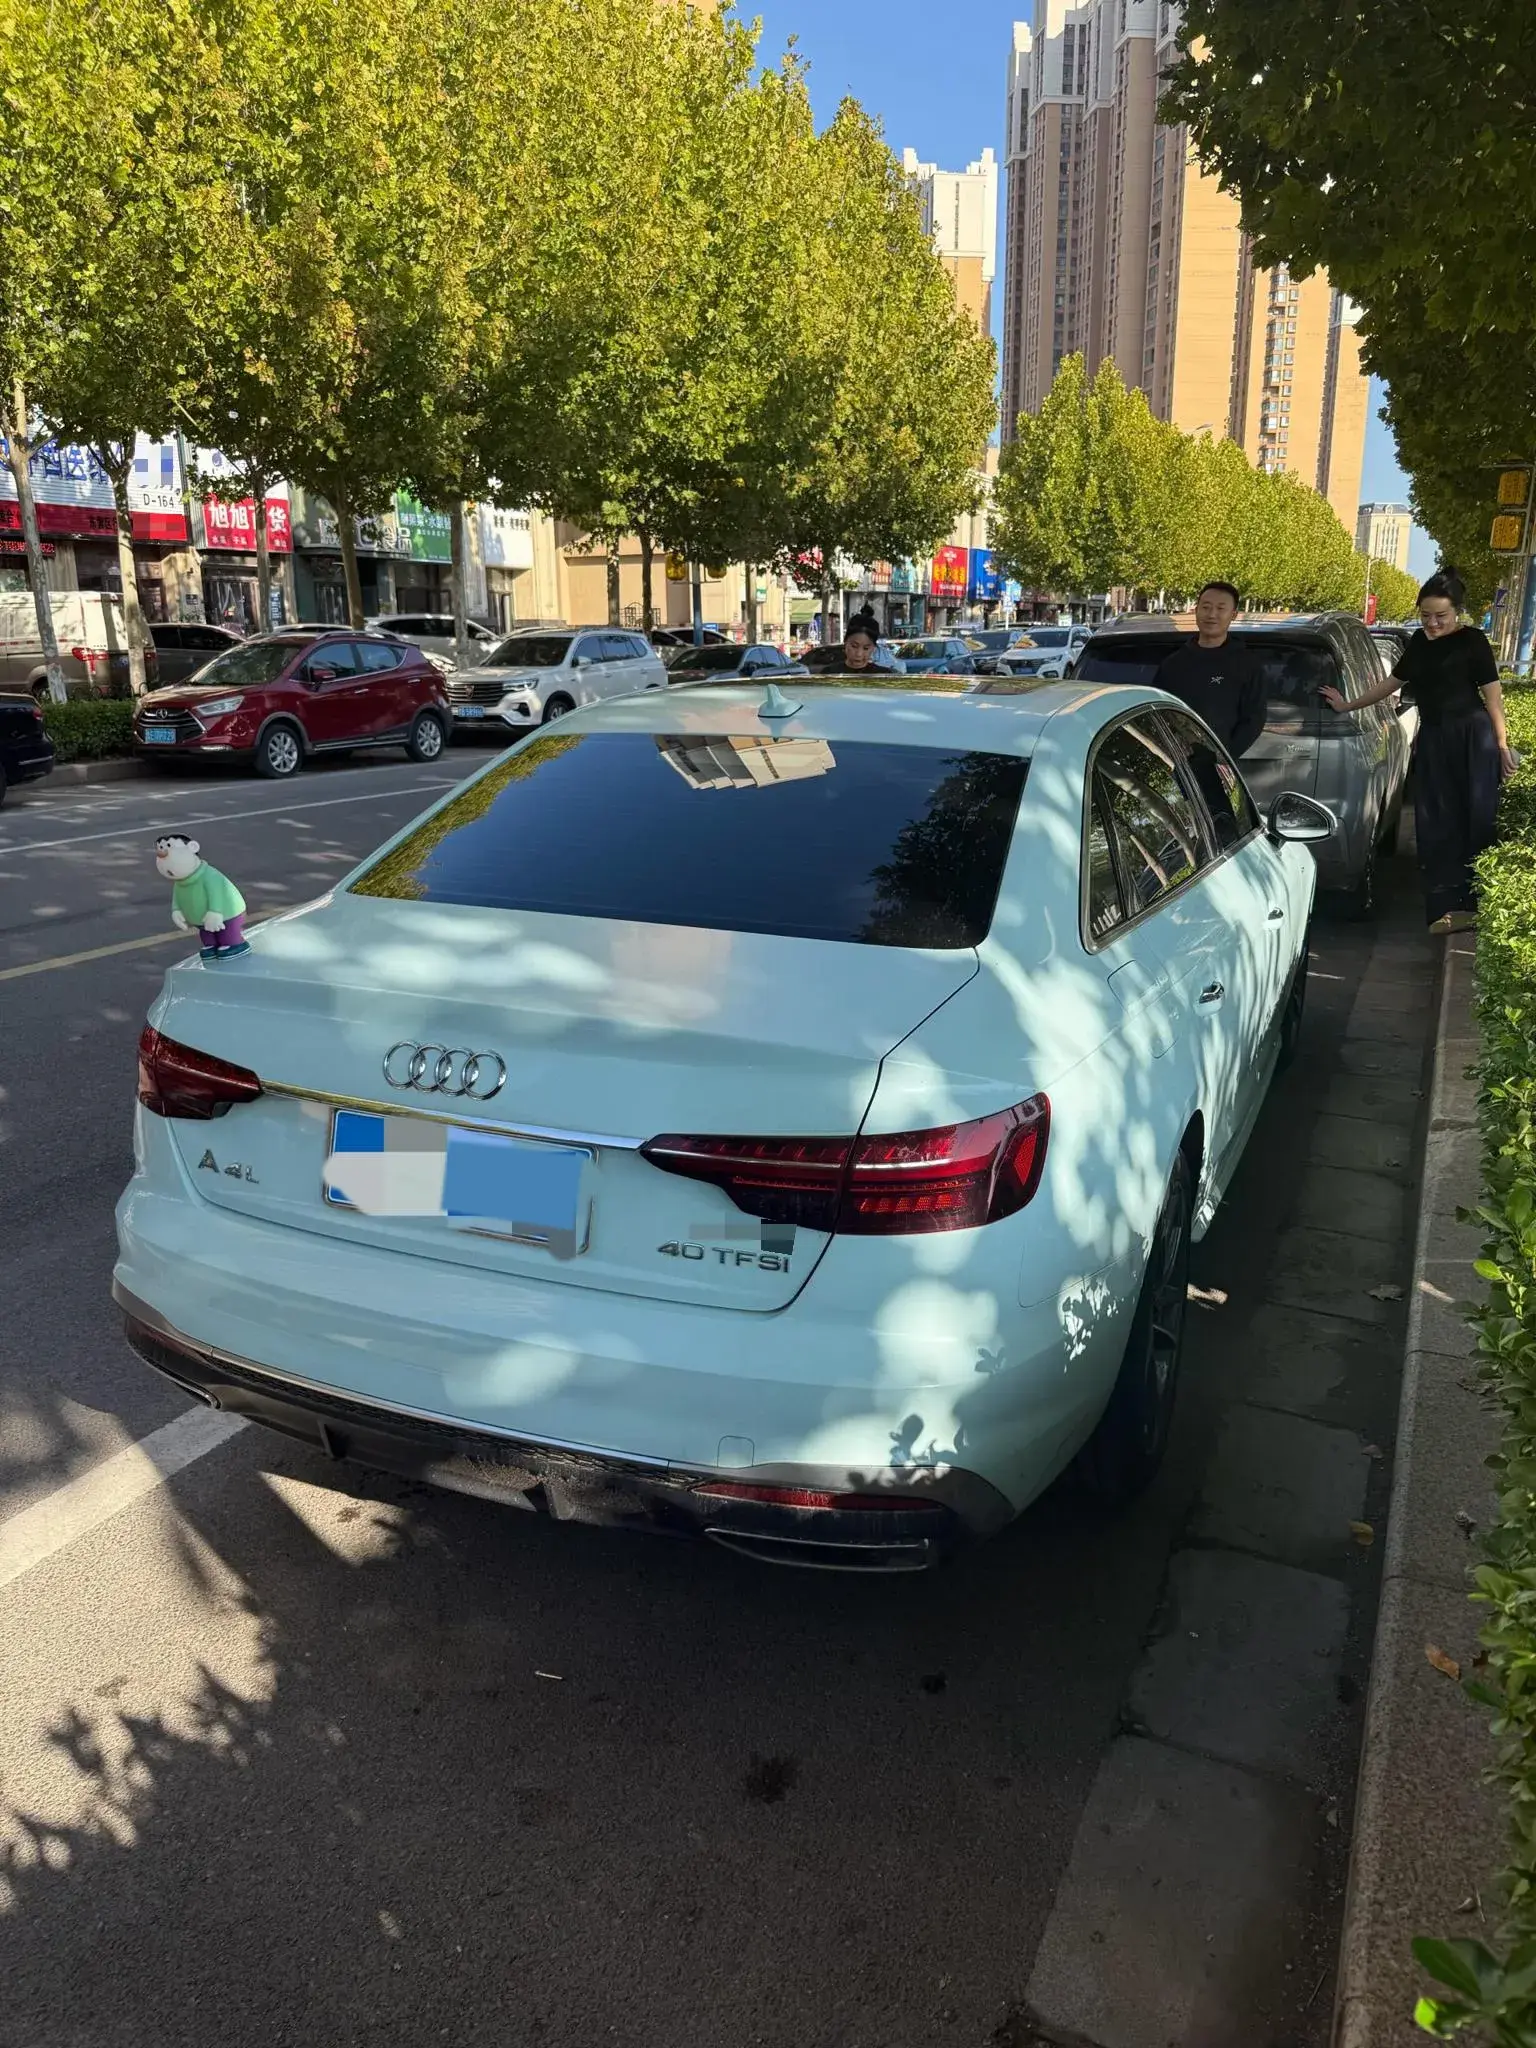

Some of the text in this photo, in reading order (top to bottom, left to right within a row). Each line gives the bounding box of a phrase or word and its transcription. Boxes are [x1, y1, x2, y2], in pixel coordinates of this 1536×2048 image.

[144, 494, 174, 508] D-164
[657, 1239, 790, 1274] 40 TFSI
